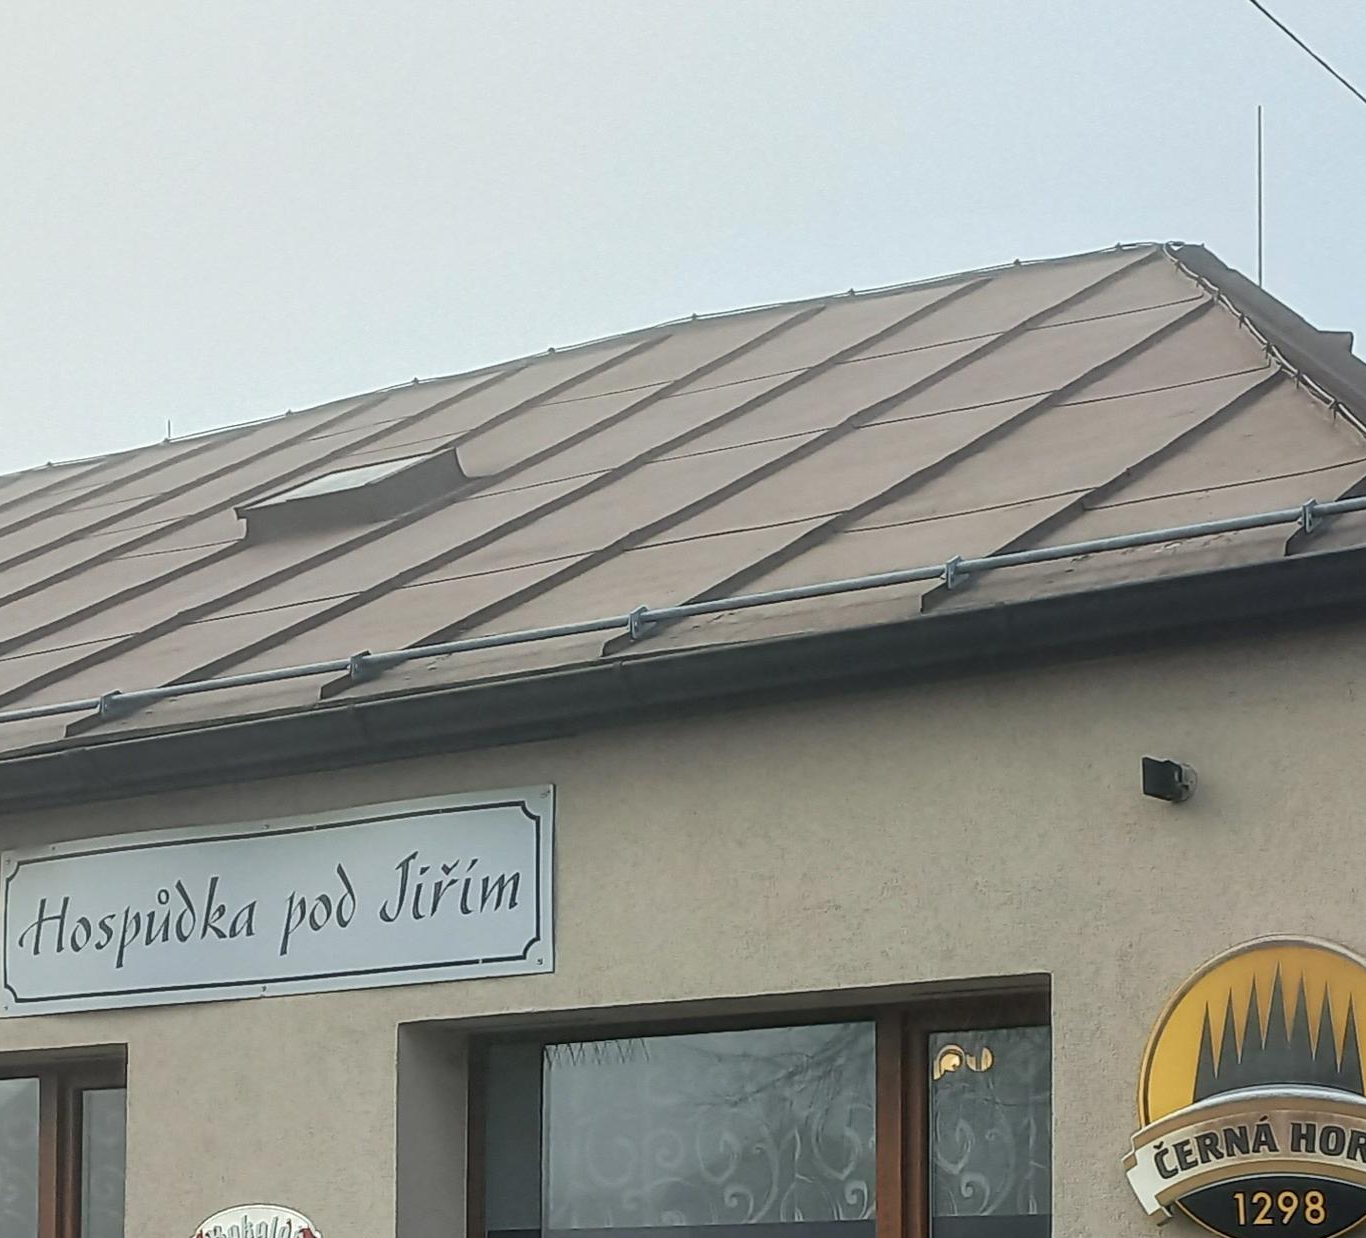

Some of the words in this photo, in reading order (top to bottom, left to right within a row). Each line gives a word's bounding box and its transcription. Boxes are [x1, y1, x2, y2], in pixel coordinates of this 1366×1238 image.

[18, 875, 257, 969] Hospůdka
[279, 862, 357, 957] pod
[378, 850, 521, 923] Jiřím
[1153, 1115, 1280, 1180] ČERNÁ
[1233, 1190, 1327, 1226] 1298
